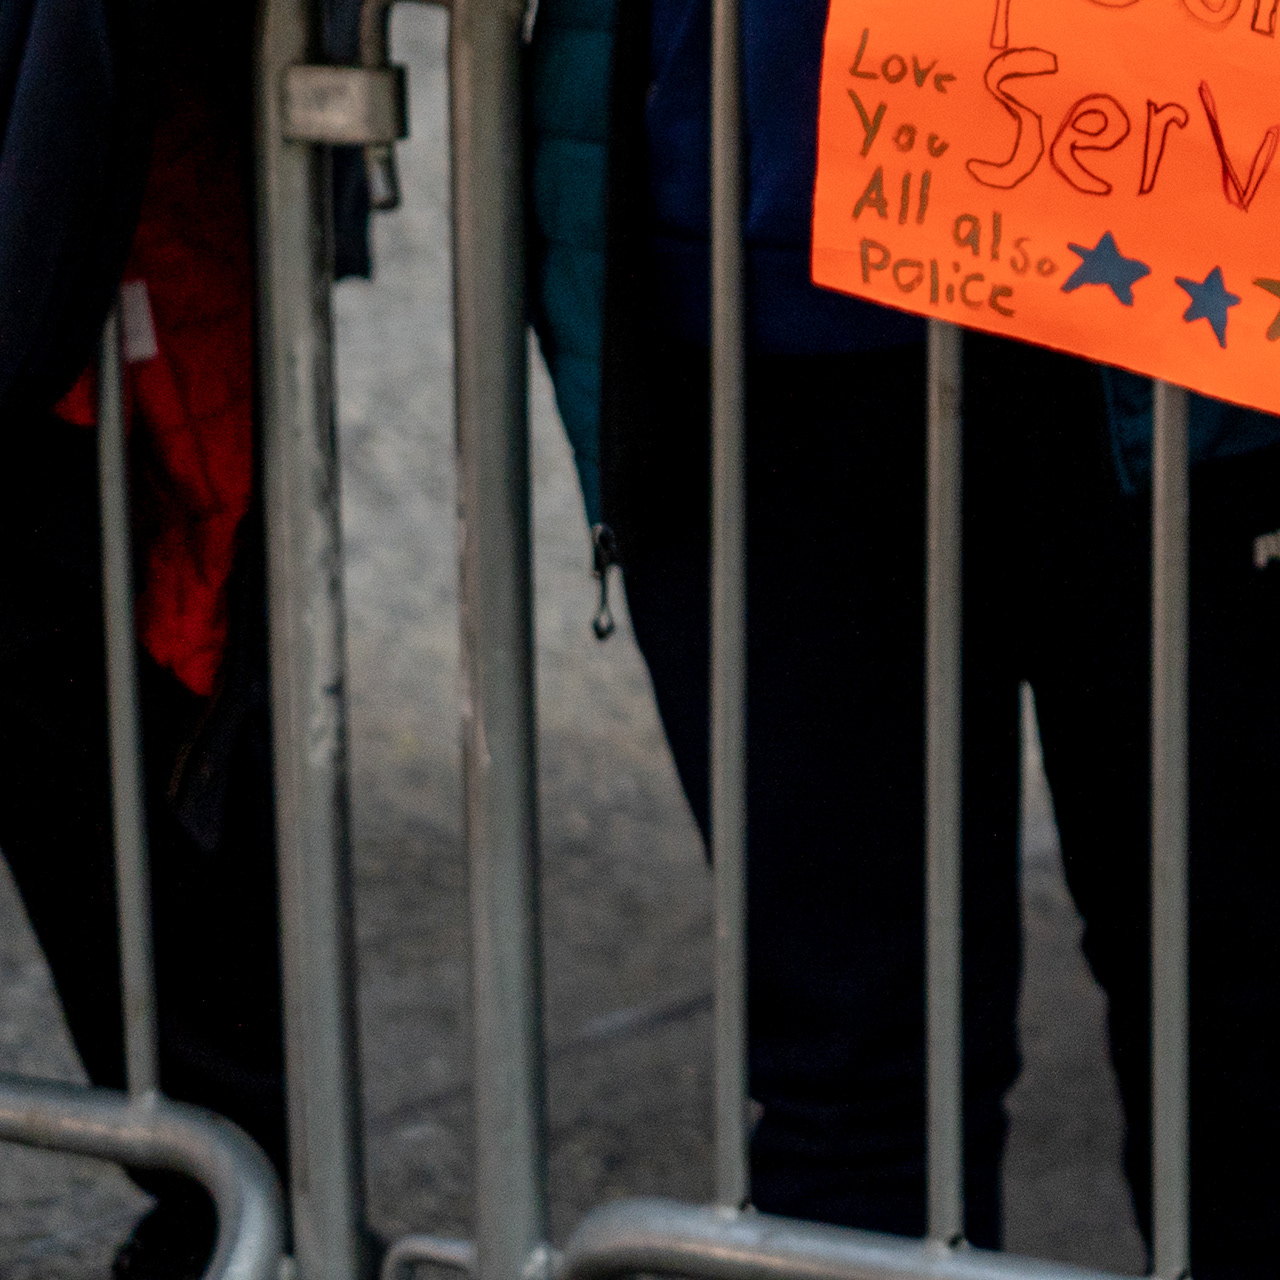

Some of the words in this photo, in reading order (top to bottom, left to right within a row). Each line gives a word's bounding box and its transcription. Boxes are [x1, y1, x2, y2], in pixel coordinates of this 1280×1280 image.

[849, 28, 957, 94] Love
[847, 88, 950, 158] You
[852, 166, 931, 225] All
[952, 210, 1059, 278] also
